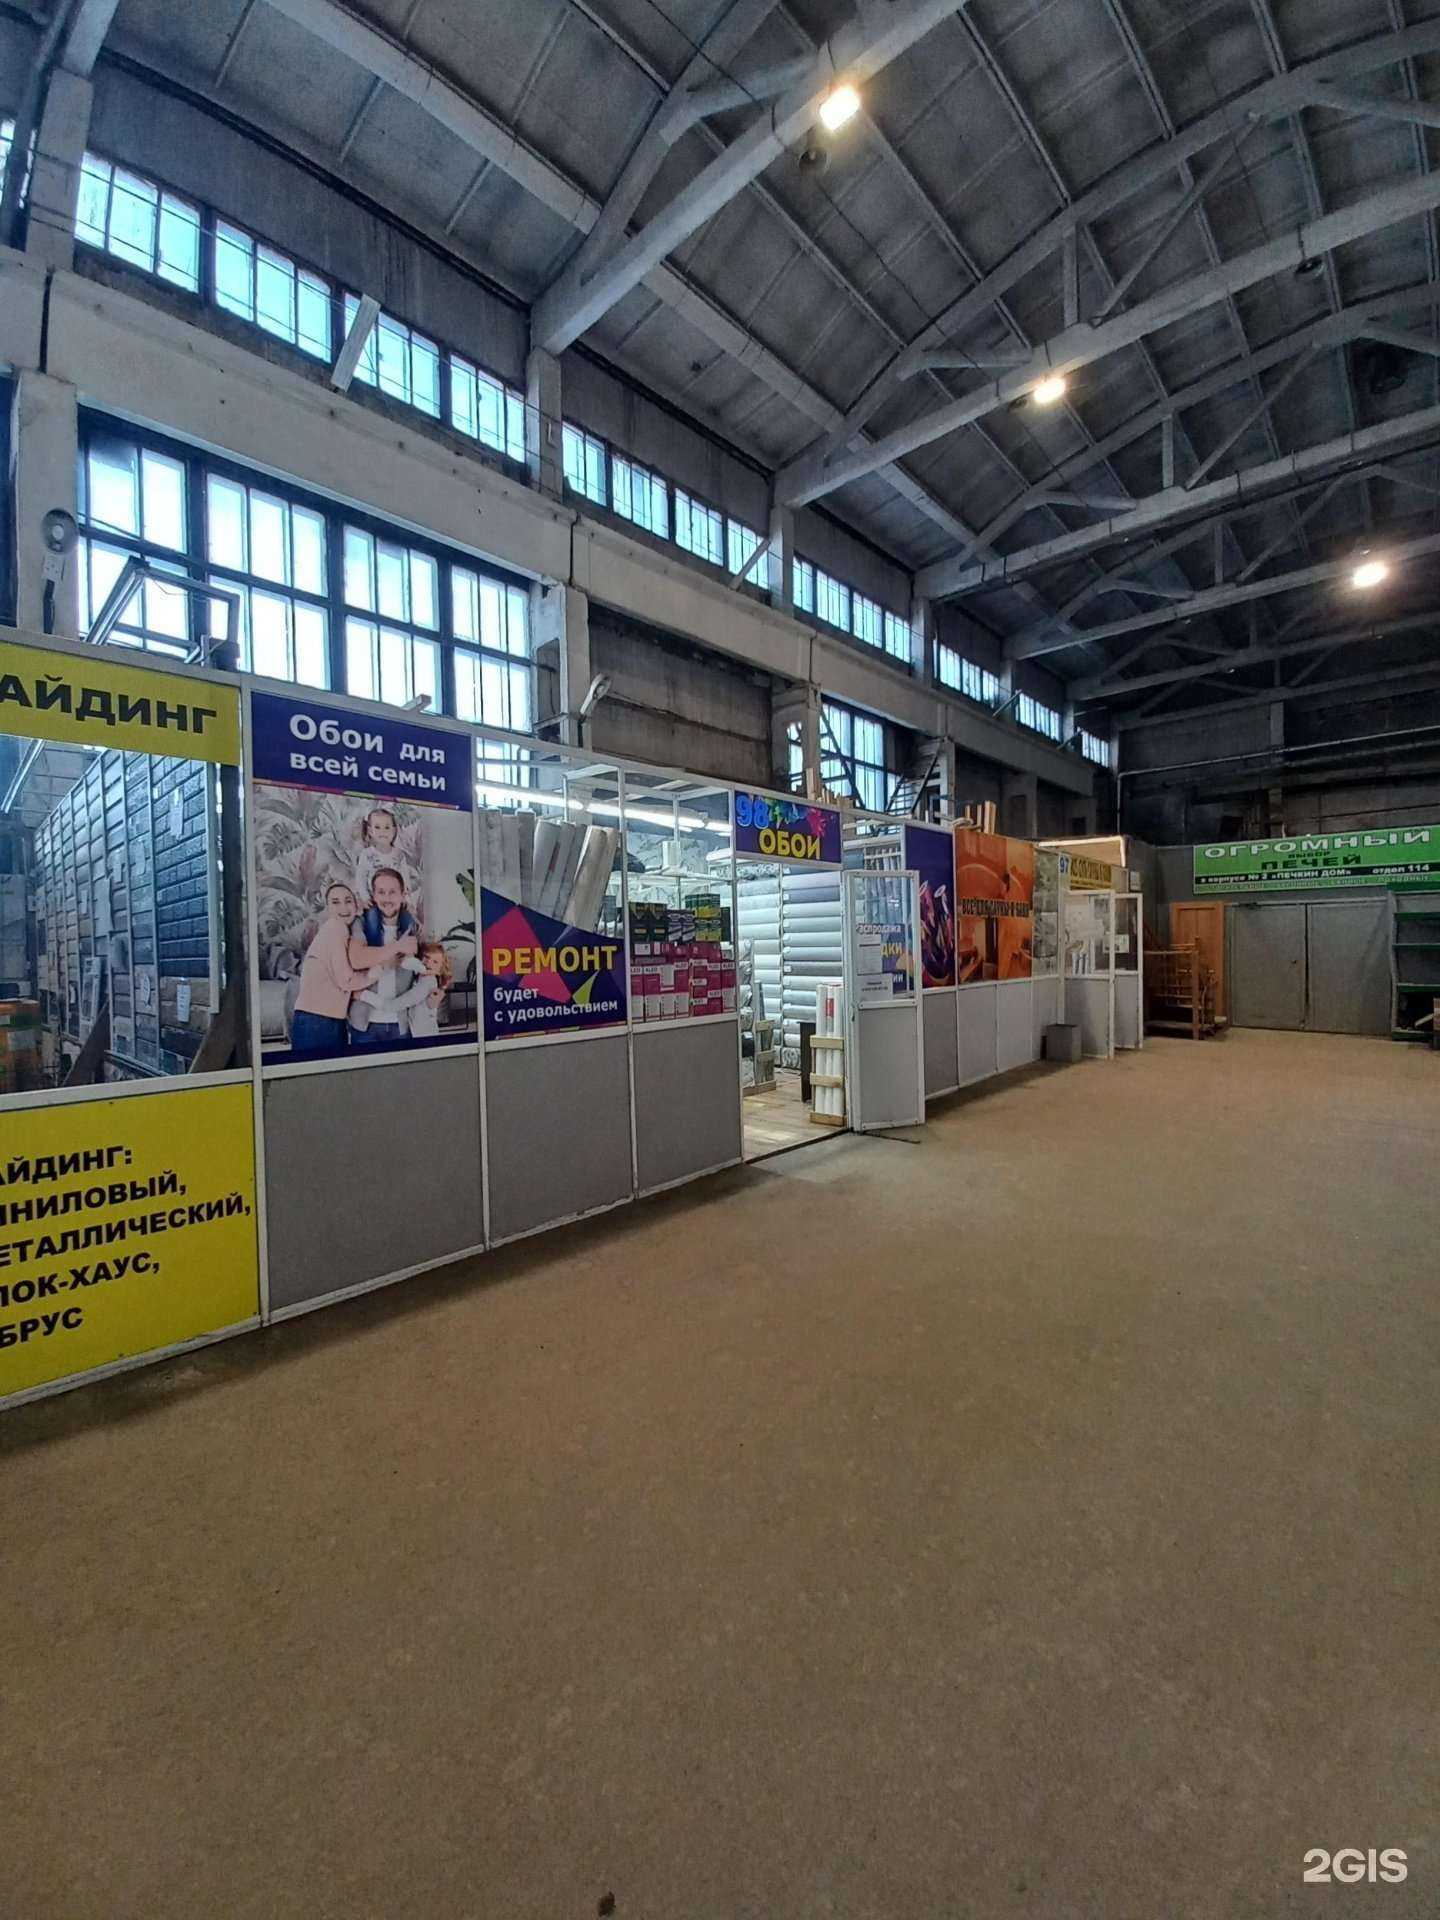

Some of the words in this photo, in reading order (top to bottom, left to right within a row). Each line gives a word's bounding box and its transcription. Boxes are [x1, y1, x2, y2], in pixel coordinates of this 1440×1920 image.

[289, 714, 384, 753] Обои
[399, 743, 446, 764] для
[290, 753, 359, 778] всей
[368, 765, 446, 791] семьи
[735, 794, 769, 830] 98
[759, 828, 820, 860] ОБОИ
[1204, 829, 1430, 858] ОГРОМНЫЙ
[1261, 853, 1361, 870] ПЕЧЕЙ
[1408, 864, 1430, 872] 114
[491, 945, 618, 975] РЕМОНТ
[493, 986, 539, 1004] будет
[494, 1011, 503, 1022] с
[508, 1000, 618, 1024] удовольствием
[0, 1306, 83, 1349] БРУС
